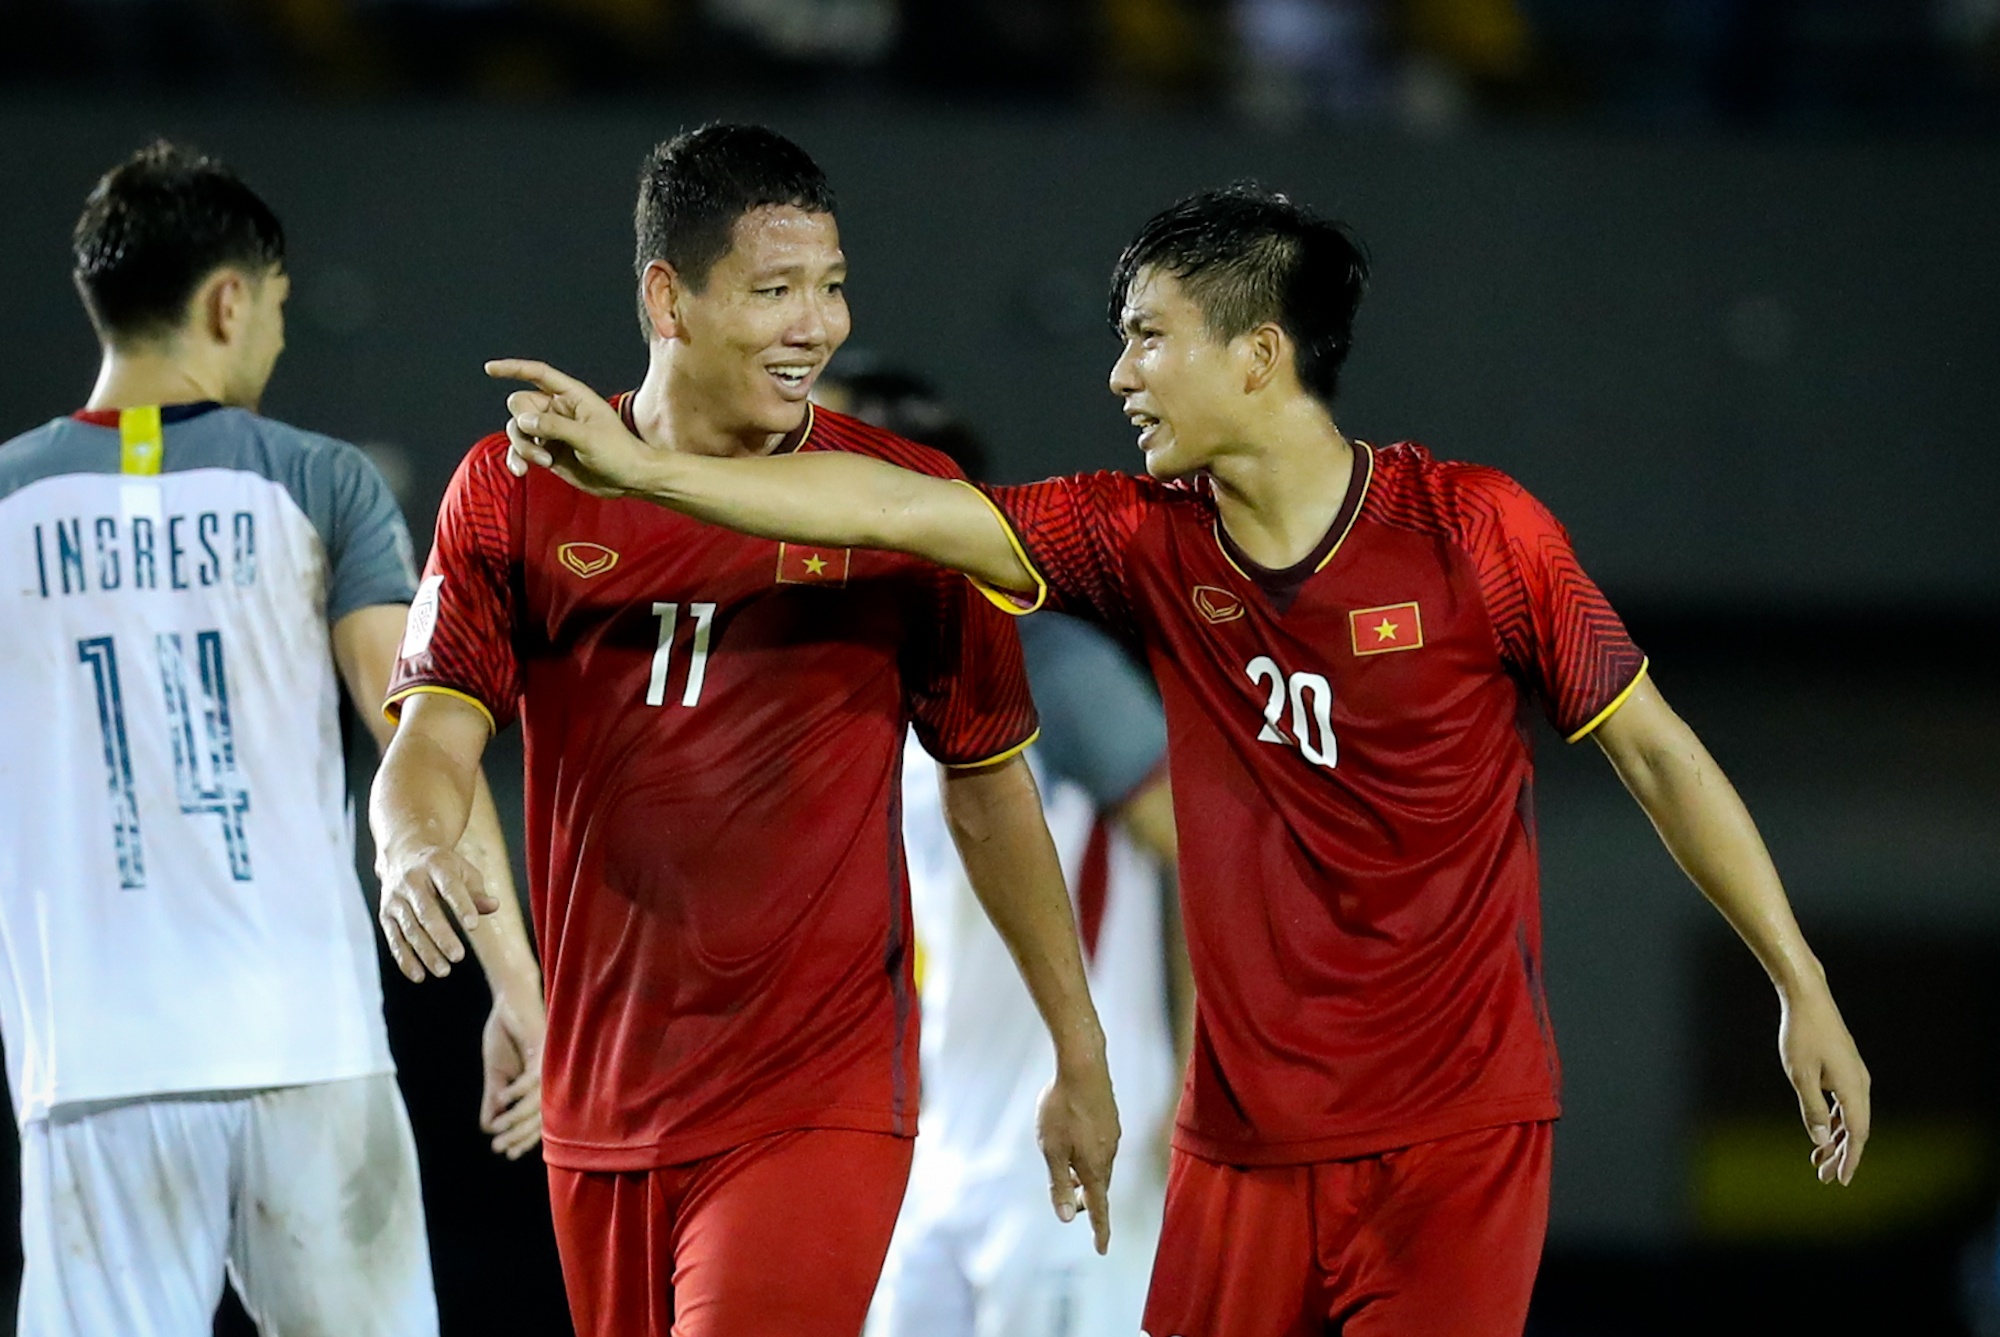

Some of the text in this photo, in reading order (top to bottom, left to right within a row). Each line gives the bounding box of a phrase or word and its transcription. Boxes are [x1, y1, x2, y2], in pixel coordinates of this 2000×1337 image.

[35, 512, 257, 598] INGRESO
[646, 602, 716, 706] 11
[77, 630, 253, 889] 14
[1246, 656, 1338, 768] 20
